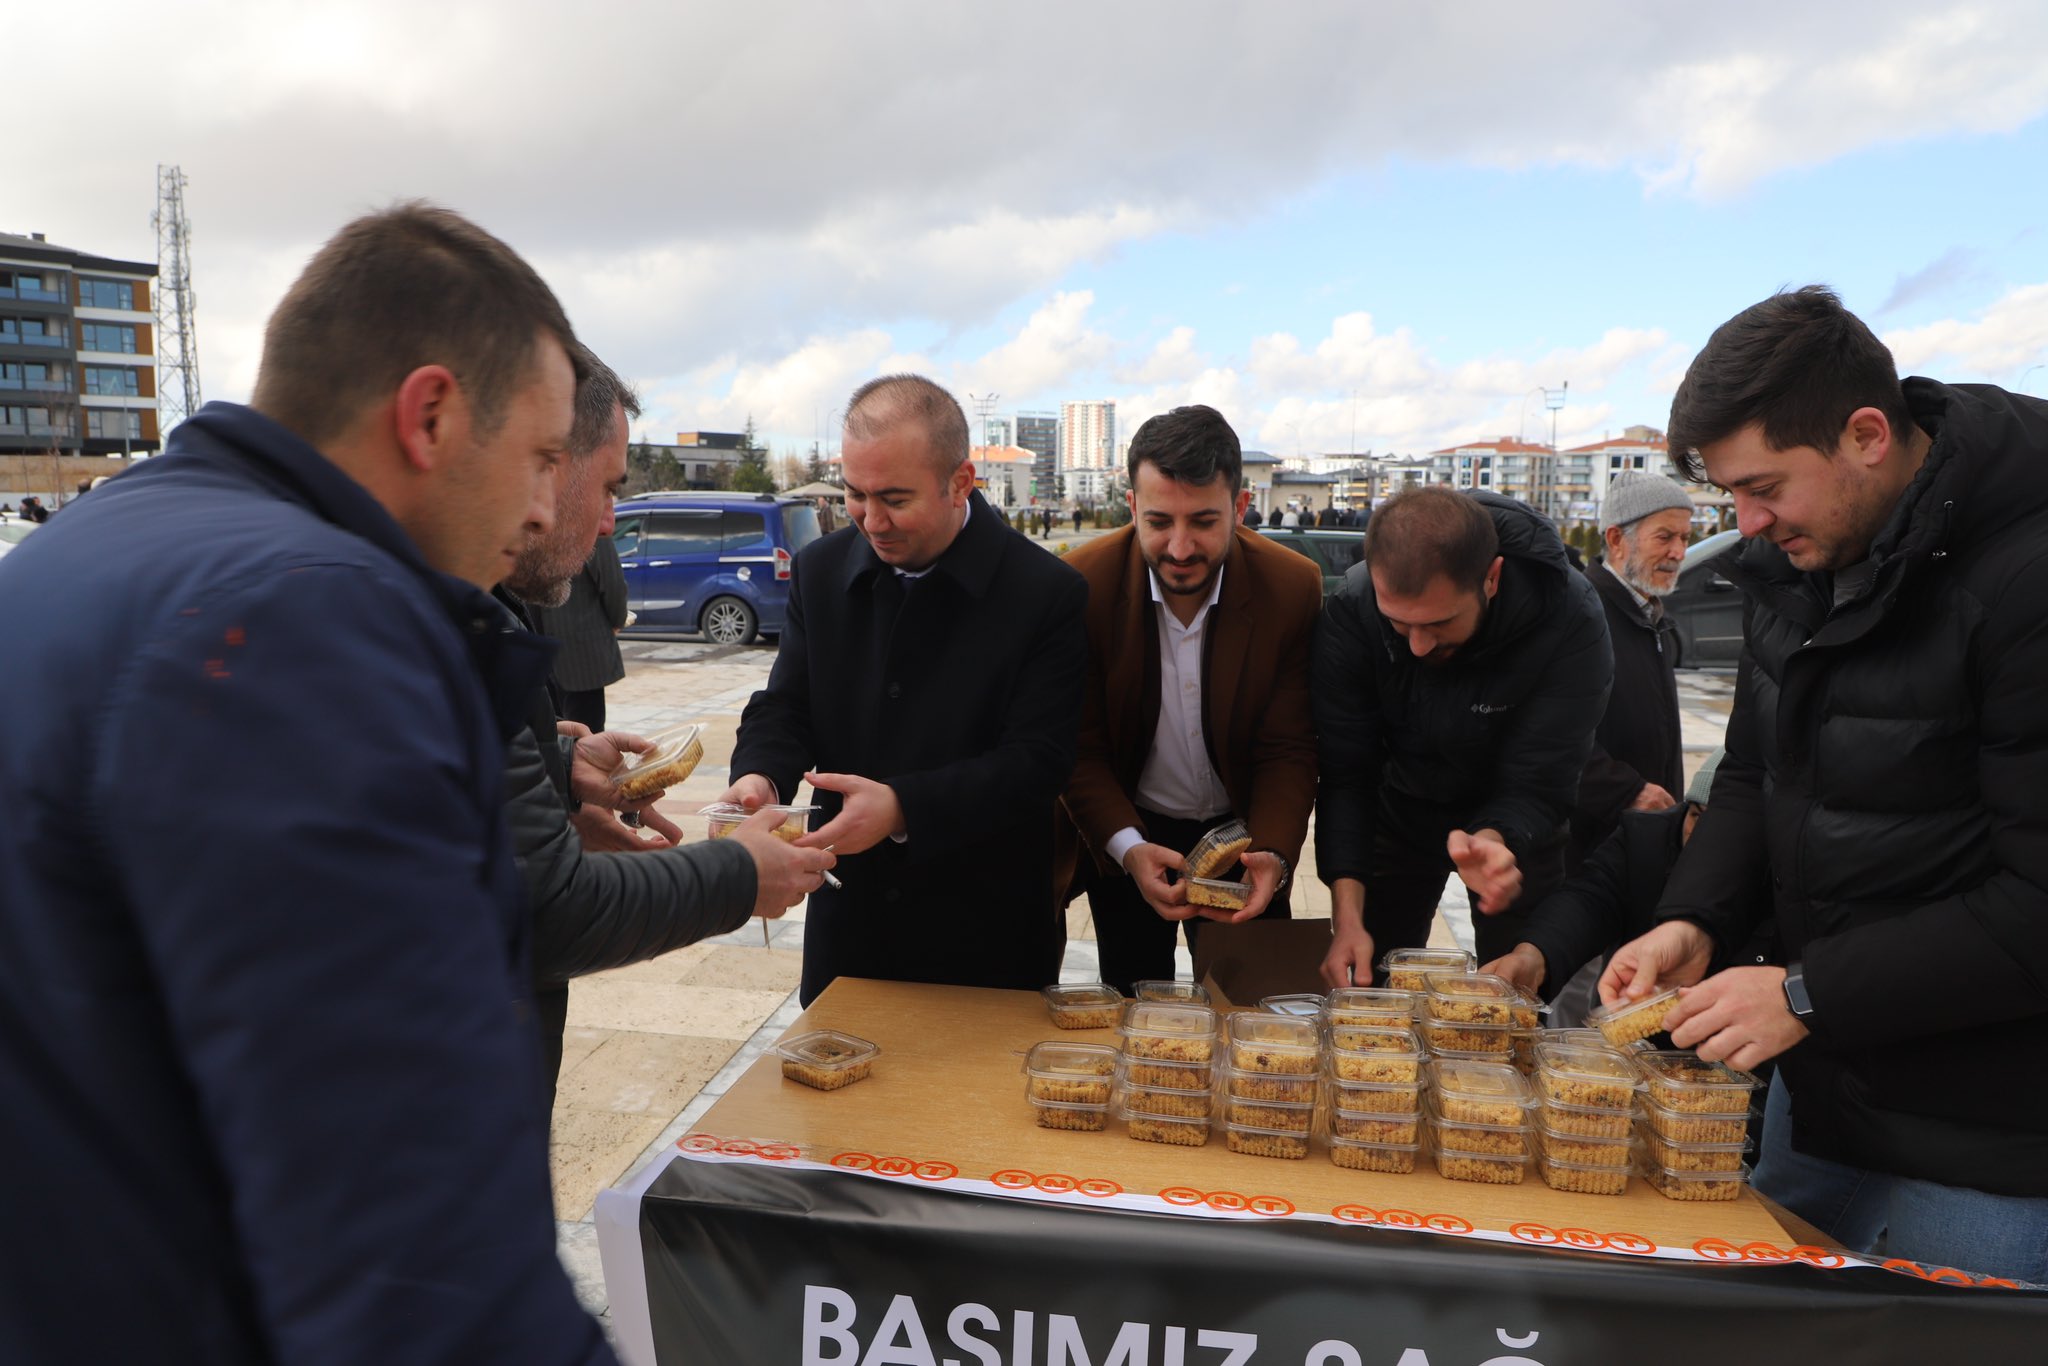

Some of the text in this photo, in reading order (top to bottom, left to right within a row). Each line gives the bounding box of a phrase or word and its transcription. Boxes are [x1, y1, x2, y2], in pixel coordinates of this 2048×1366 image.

[838, 1155, 952, 1178] TNT
[997, 1172, 1117, 1194] TNT
[1165, 1189, 1288, 1214] TNT
[1338, 1207, 1465, 1232] TNT
[1516, 1226, 1651, 1251] TNT
